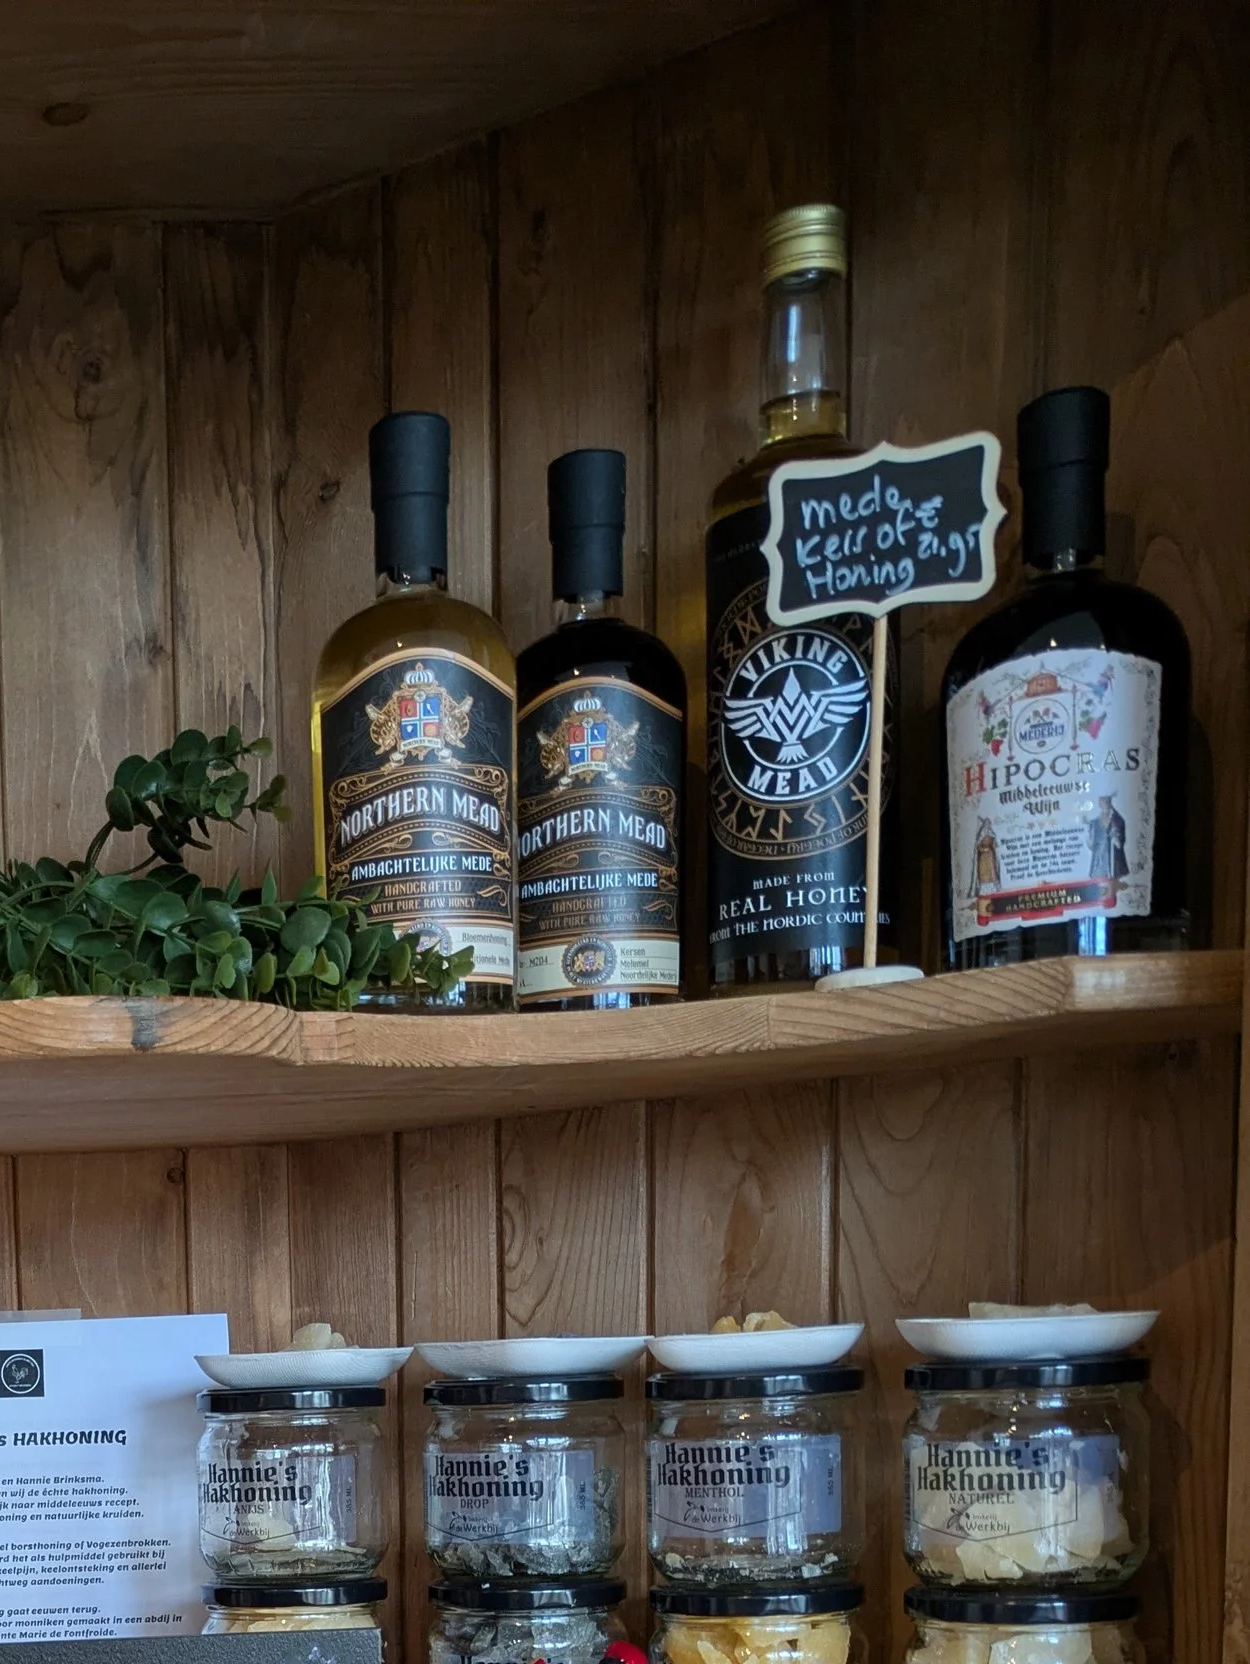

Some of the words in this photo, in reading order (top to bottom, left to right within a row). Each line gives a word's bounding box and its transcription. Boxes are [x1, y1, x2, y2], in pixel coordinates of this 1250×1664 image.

[801, 474, 899, 530] mede
[876, 498, 916, 546] of
[806, 554, 915, 600] Honing
[739, 635, 848, 682] VIKING
[747, 755, 838, 796] MEAD
[964, 748, 1141, 797] HIPOCRAS
[340, 785, 447, 848] NORTHERN
[452, 788, 500, 835] MEAD
[517, 808, 611, 861] ORTHERN
[618, 809, 666, 850] MEAD
[351, 855, 458, 882] AMBACHTELIJKE
[461, 855, 493, 872] MEDE
[384, 879, 462, 897] HANDCRAFTED
[521, 872, 623, 899] AMBACHTELIJKE
[626, 872, 659, 888] MEDE
[753, 874, 791, 891] MADE
[370, 902, 394, 915] WITH
[396, 899, 420, 912] PURE
[423, 897, 446, 909] RAW
[447, 896, 476, 908] HONEY
[718, 893, 773, 922] REAL
[12, 1429, 127, 1446] HAKHONING
[434, 1453, 530, 1478] Hannie's
[1, 1477, 14, 1486] en
[15, 1475, 51, 1485] Hannie
[53, 1474, 105, 1484] Brinksma.
[428, 1474, 544, 1502] Hakhoning
[9, 1487, 25, 1499] wij
[27, 1487, 40, 1497] de
[41, 1486, 69, 1497] échte
[71, 1485, 128, 1496] hakhoning.
[10, 1501, 35, 1509] naar
[36, 1498, 103, 1509] middeleeuws
[104, 1497, 139, 1508] recept.
[29, 1513, 42, 1521] en
[43, 1509, 100, 1521] natuurlijke
[101, 1508, 144, 1519] kruiden.
[459, 1497, 489, 1510] DROP
[10, 1540, 72, 1551] borsthoning
[73, 1539, 85, 1550] of
[85, 1538, 171, 1550] Vogezenbrokken.
[11, 1553, 29, 1563] het
[29, 1552, 46, 1562] als
[47, 1551, 105, 1562] hulpmiddel
[107, 1549, 150, 1562] gebruikt
[151, 1548, 165, 1560] bij
[40, 1562, 115, 1574] keelontsteking
[116, 1563, 129, 1572] en
[130, 1560, 167, 1571] allerlei
[29, 1575, 105, 1586] aandoeningen.
